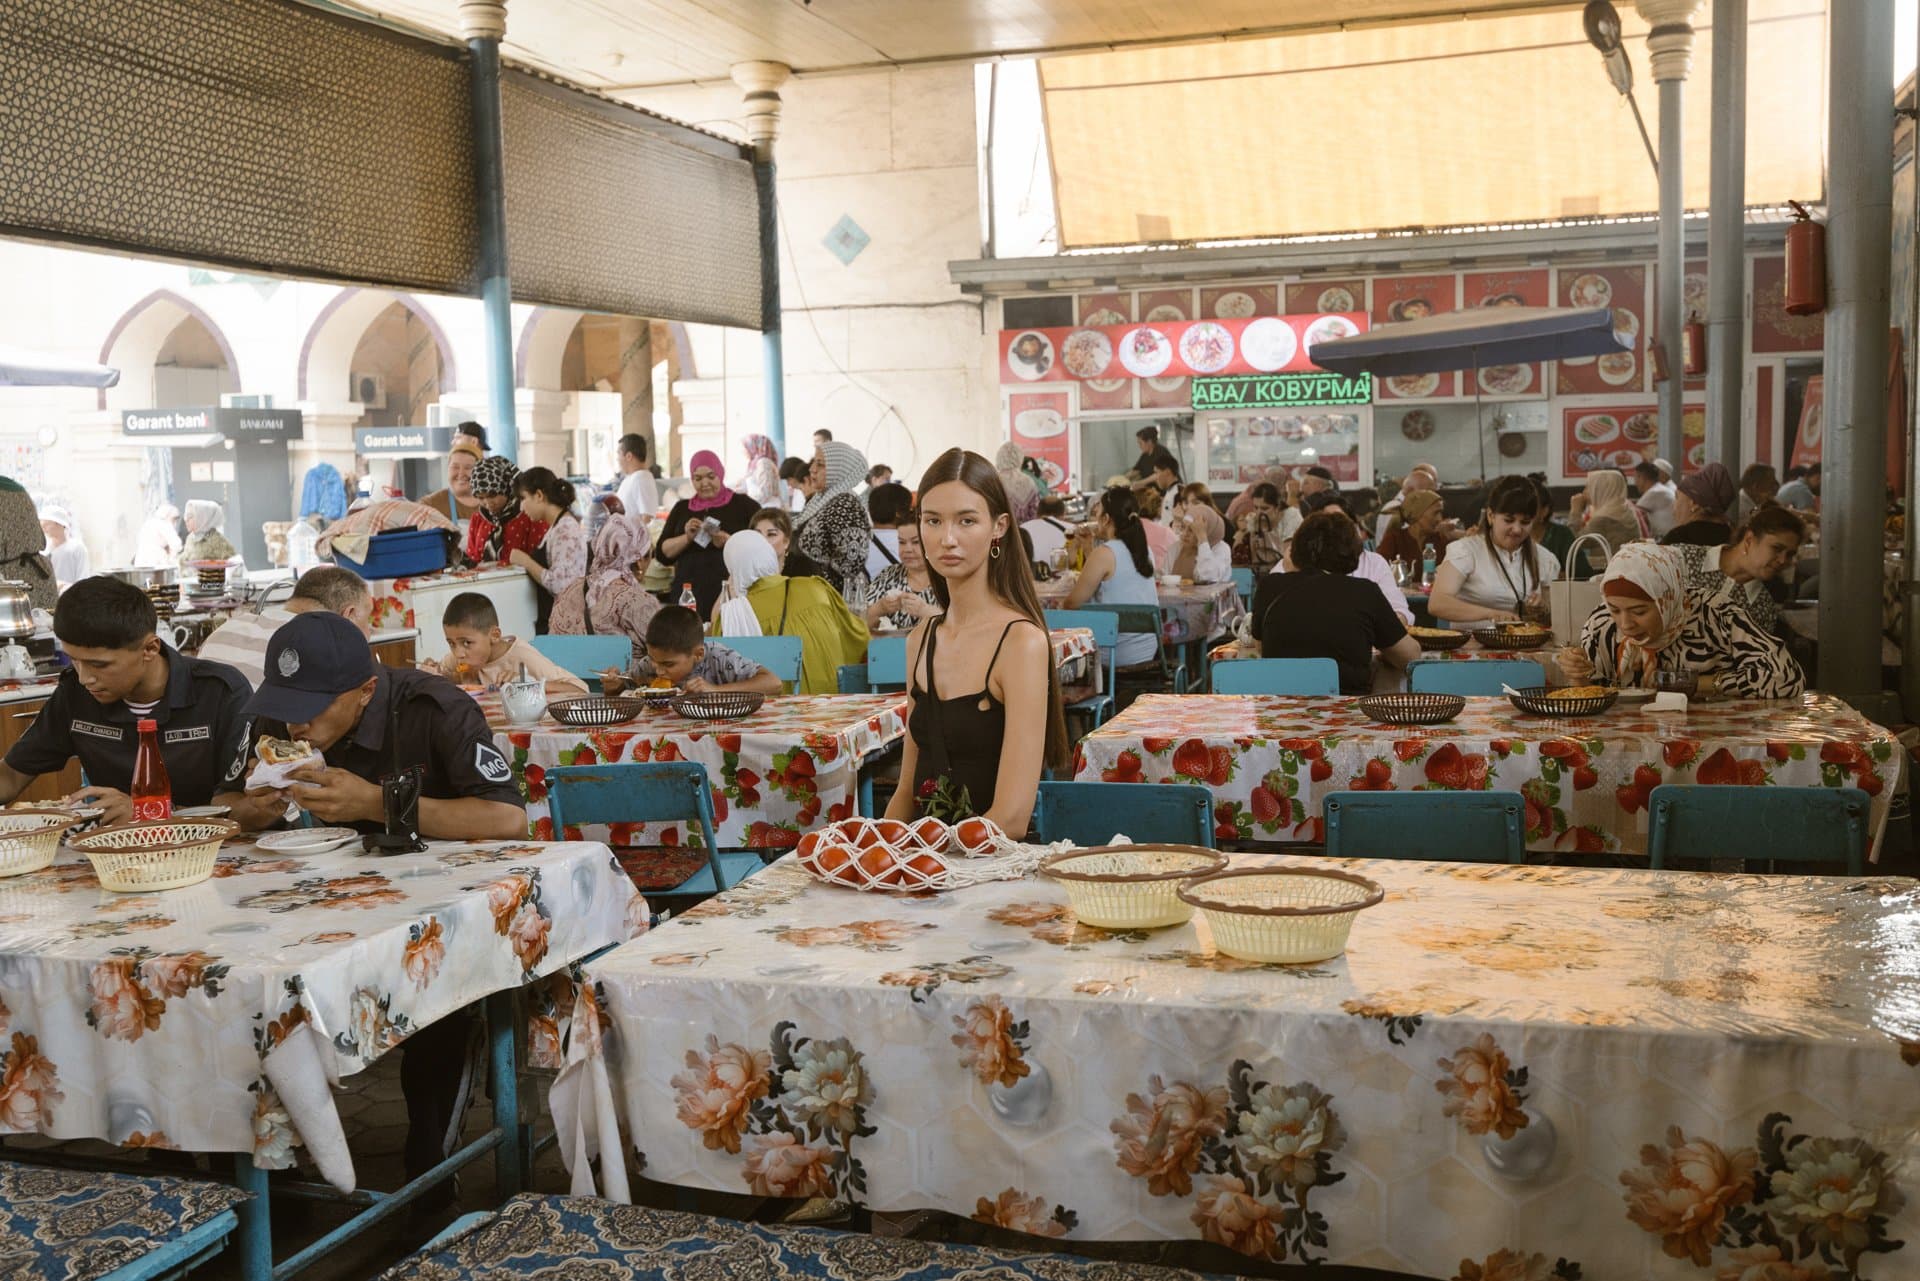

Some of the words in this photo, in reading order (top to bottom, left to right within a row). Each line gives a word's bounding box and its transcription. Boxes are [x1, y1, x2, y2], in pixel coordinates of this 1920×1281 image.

[1255, 378, 1369, 401] КОВУРМА
[126, 414, 173, 430] Garant
[175, 411, 209, 429] bank
[363, 434, 398, 448] Garant
[399, 433, 425, 446] bank
[481, 757, 507, 777] MG
